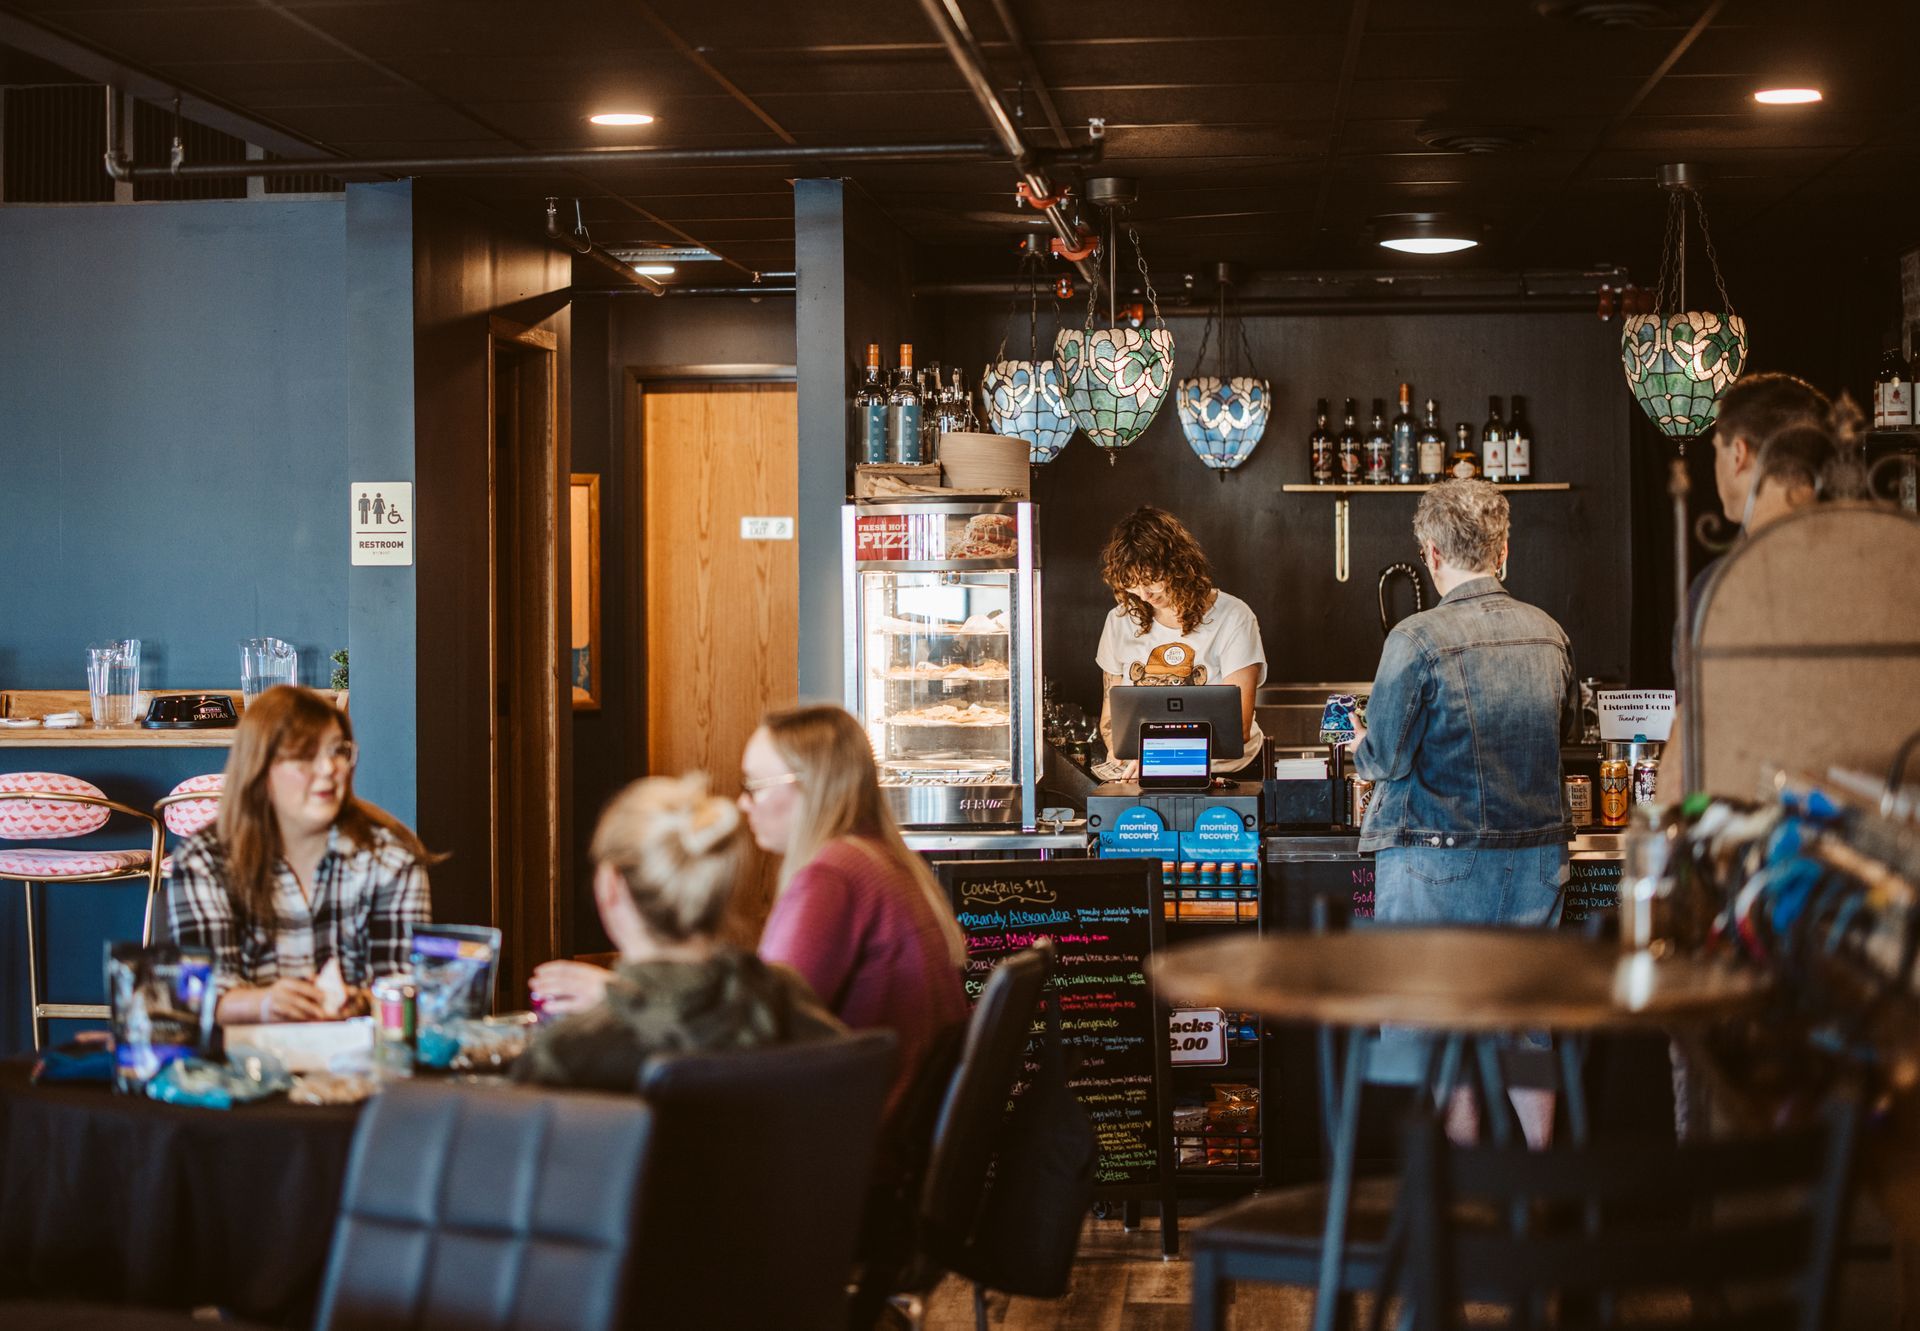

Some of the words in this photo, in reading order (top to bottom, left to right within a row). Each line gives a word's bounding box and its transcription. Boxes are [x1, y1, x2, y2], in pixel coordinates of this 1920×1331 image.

[359, 541, 404, 549] RESTROOM
[1603, 703, 1644, 711] Listening
[1617, 714, 1634, 722] Thank
[1120, 821, 1158, 833] morning
[1200, 821, 1239, 833] morning
[961, 879, 1023, 896] Cocktails
